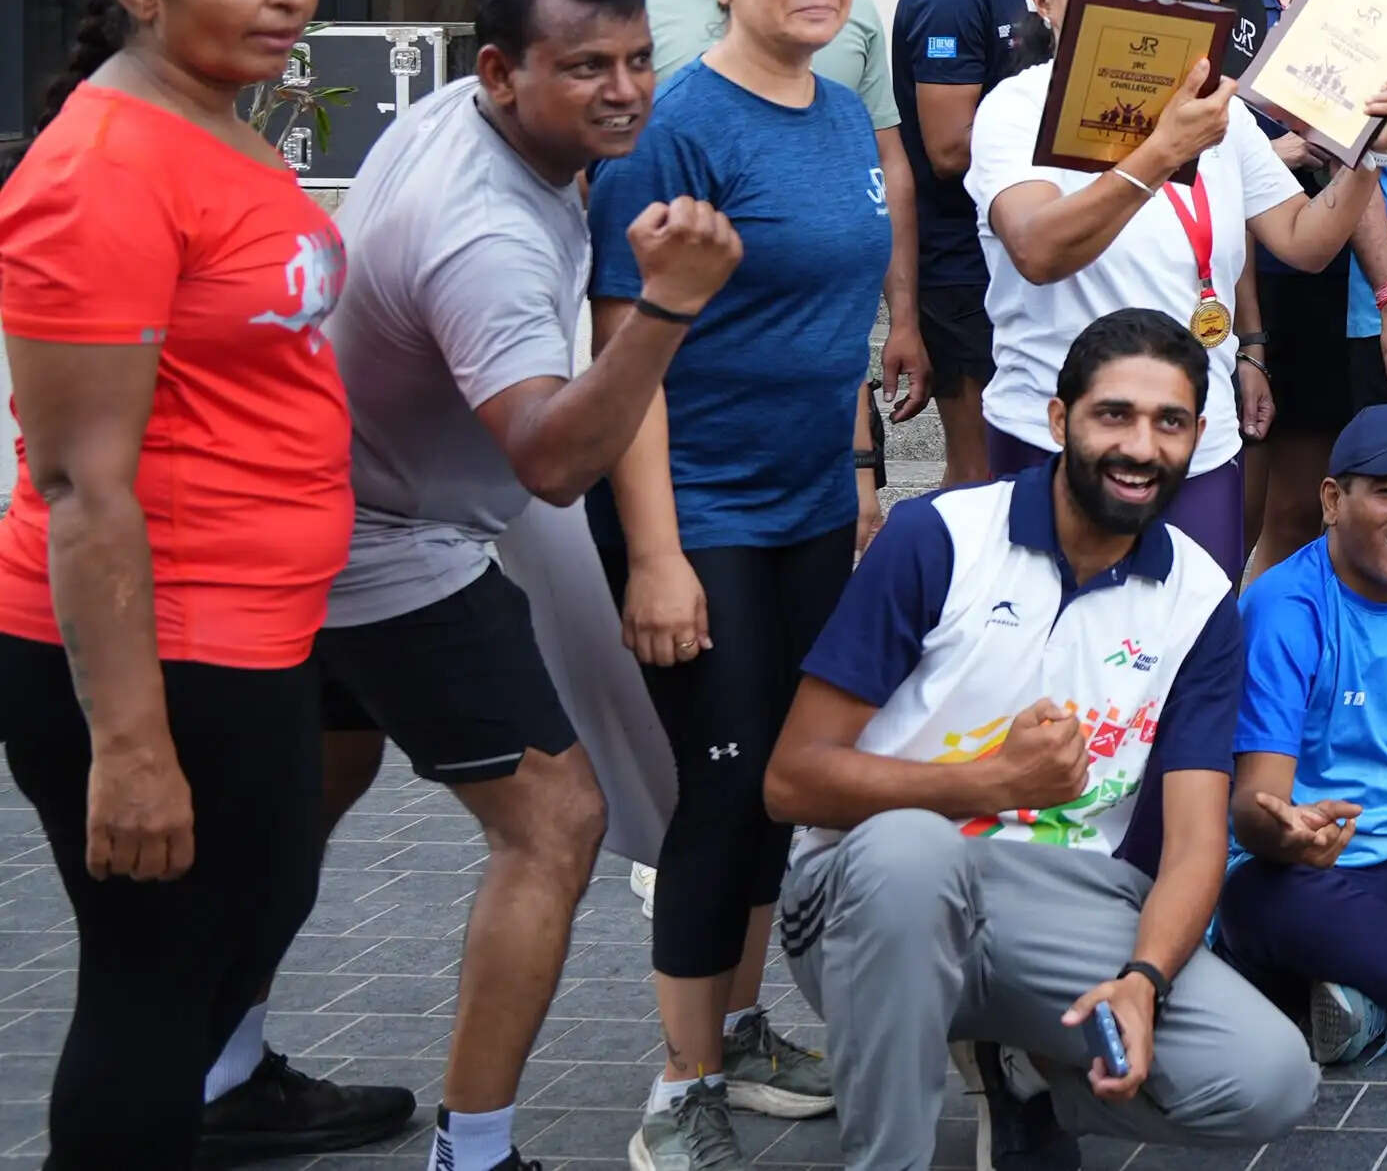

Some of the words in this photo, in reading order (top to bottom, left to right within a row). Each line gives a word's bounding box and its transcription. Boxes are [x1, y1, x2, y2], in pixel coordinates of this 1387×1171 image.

[1129, 36, 1159, 54] JR
[1232, 17, 1256, 50] JR
[436, 1131, 454, 1171] NIK
